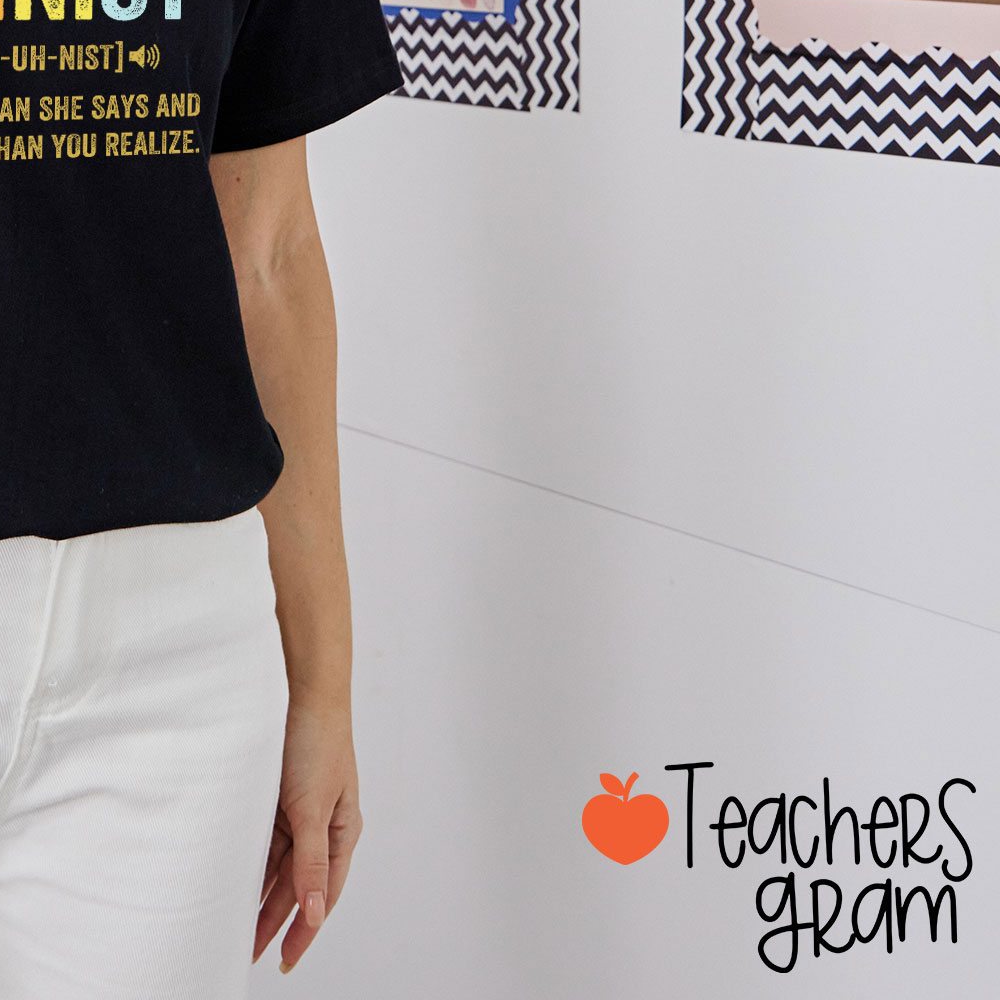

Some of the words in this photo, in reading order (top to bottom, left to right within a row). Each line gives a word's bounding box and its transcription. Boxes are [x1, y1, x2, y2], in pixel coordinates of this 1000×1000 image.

[39, 95, 84, 121] SHE
[91, 94, 149, 120] SAYS
[156, 92, 200, 118] AND
[51, 133, 97, 158] YOU
[105, 130, 200, 156] REALIZE.
